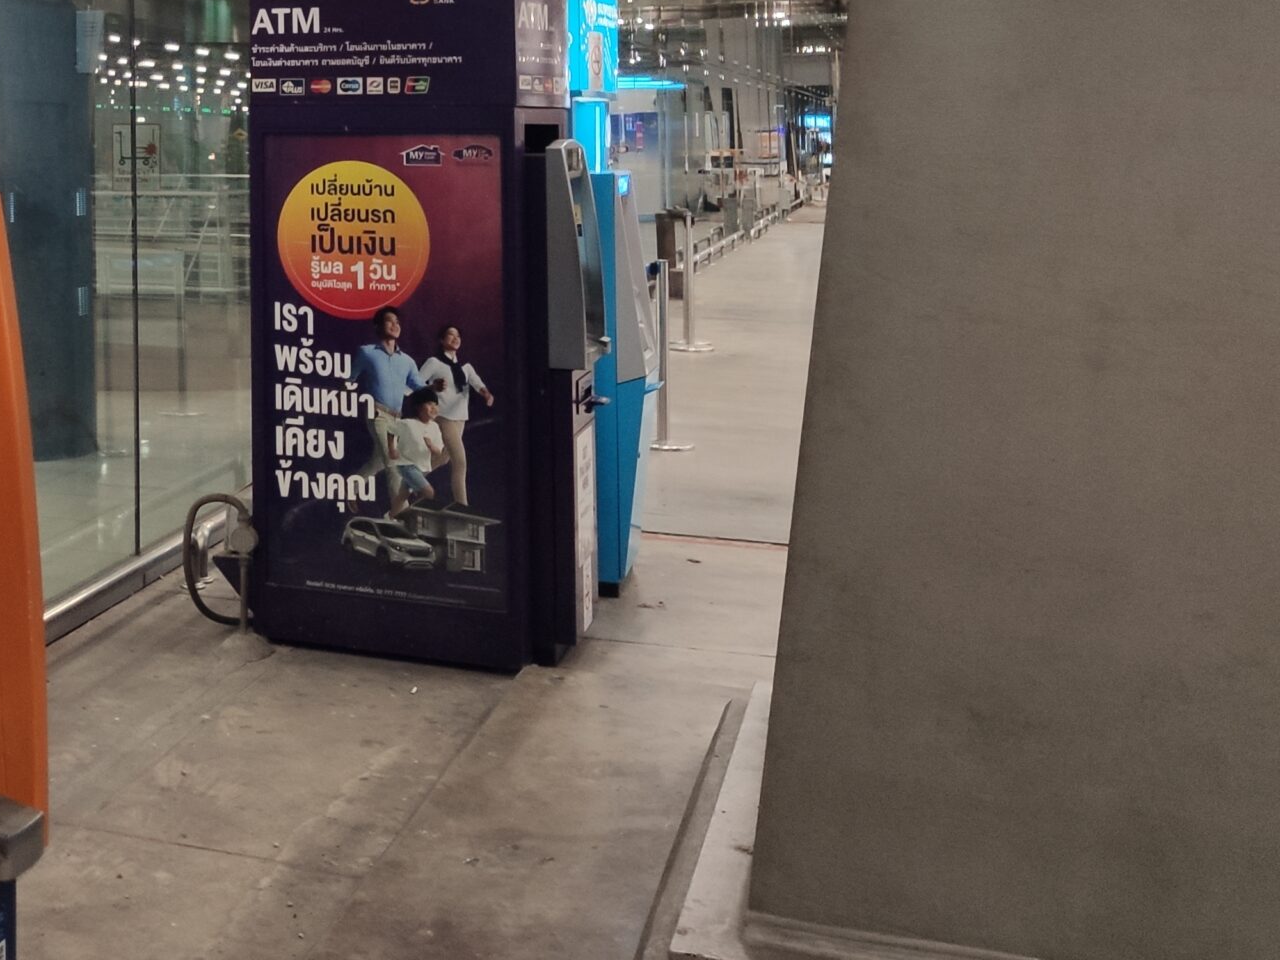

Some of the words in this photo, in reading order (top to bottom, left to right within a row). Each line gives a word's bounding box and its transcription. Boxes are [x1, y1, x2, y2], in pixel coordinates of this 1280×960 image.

[251, 6, 320, 36] ATM
[517, 1, 549, 31] ATM
[254, 81, 275, 90] VISA
[310, 174, 395, 198] เปลี่ยนบ้าน
[310, 197, 396, 224] เปลี่ยนรถ
[310, 223, 397, 257] เป็นเงิน
[310, 256, 344, 281] รู้ผล
[350, 260, 365, 291] 1
[369, 258, 397, 281] วัน
[274, 301, 314, 336] เรา
[274, 337, 352, 380] พร้อม
[274, 377, 376, 420] เดินหน้า
[275, 415, 346, 461] เคียง
[274, 458, 377, 514] ข้างคุณ
